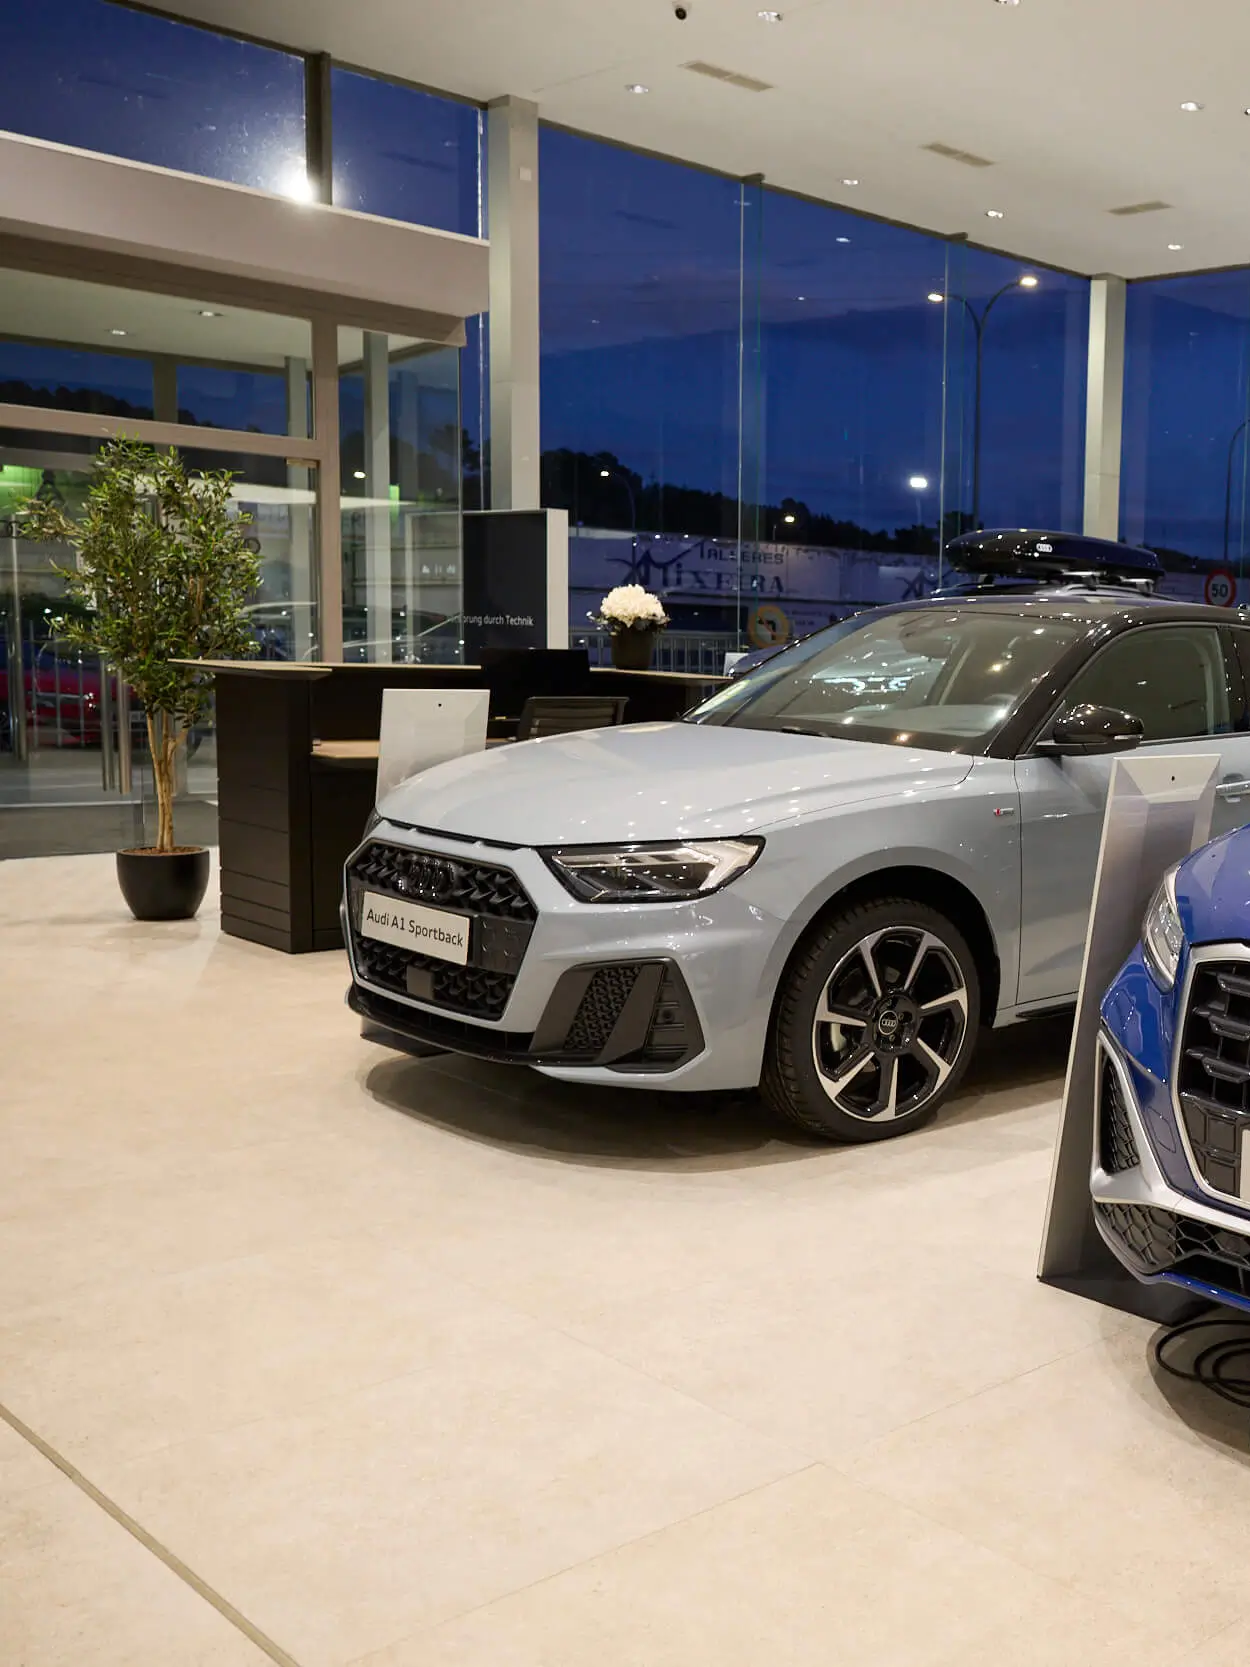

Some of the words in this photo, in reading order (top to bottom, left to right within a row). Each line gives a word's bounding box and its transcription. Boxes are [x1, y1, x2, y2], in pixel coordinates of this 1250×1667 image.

[699, 540, 785, 565] TALLERES
[1211, 583, 1229, 598] 50
[483, 613, 504, 625] durch
[504, 613, 535, 627] Technik
[366, 908, 389, 926] Audi
[391, 915, 405, 931] A1
[408, 919, 464, 948] Sportback
